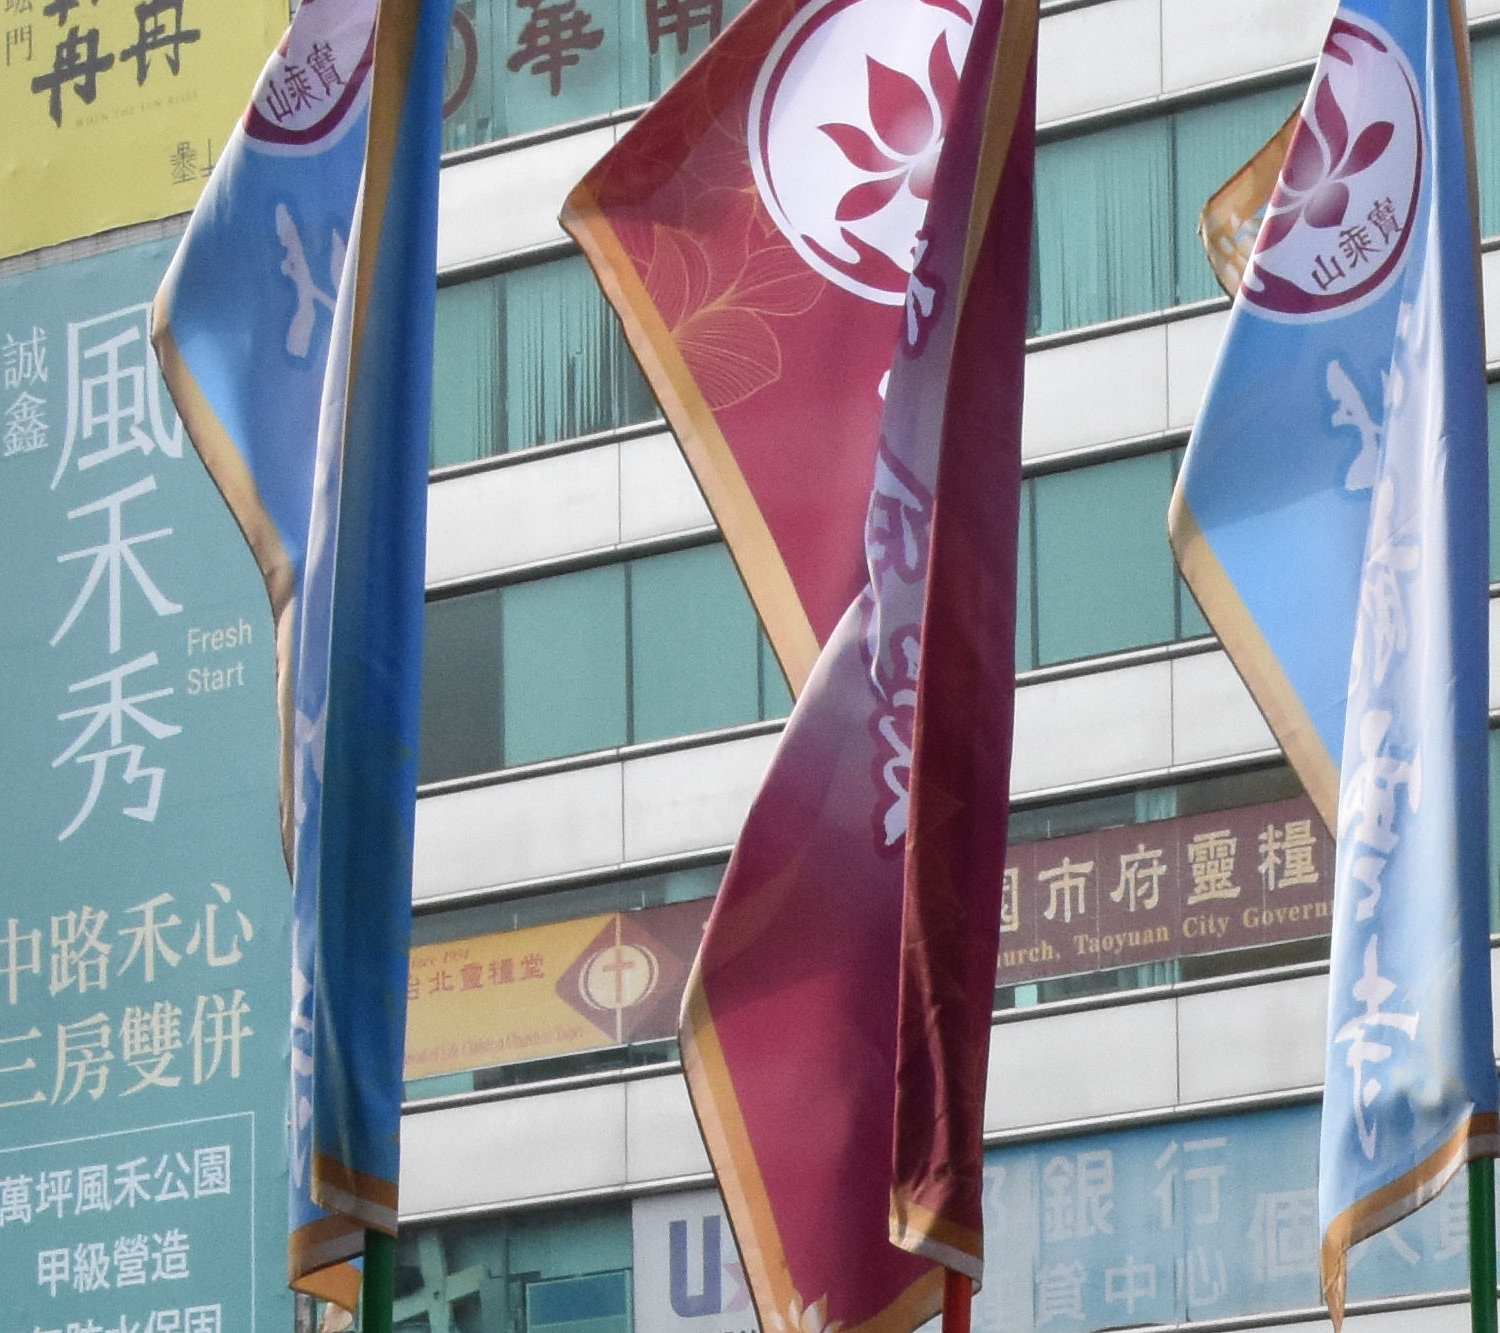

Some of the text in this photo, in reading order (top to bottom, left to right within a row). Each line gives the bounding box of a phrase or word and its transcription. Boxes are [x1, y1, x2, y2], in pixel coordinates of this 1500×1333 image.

[2, 326, 49, 457] 誠鑫
[49, 302, 184, 842] 風禾秀
[186, 617, 253, 656] Fresh
[186, 661, 245, 696] Start
[1073, 923, 1170, 956] Taoyuan
[1182, 914, 1231, 940] City
[1242, 900, 1333, 930] Govern
[36, 1228, 191, 1298] 甲級營造
